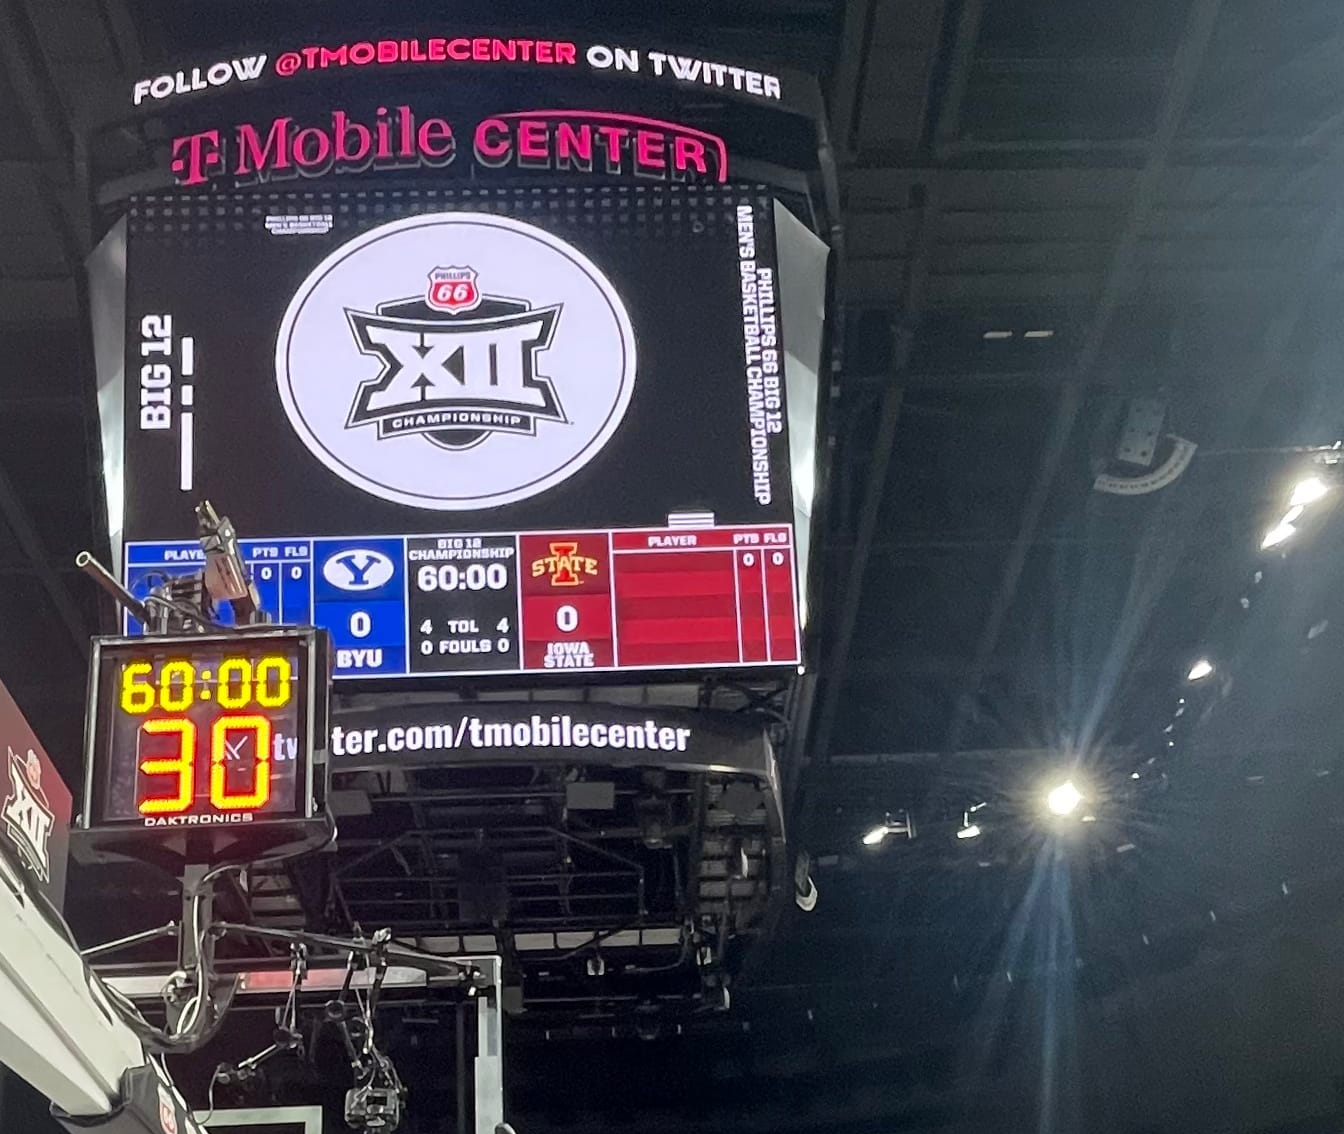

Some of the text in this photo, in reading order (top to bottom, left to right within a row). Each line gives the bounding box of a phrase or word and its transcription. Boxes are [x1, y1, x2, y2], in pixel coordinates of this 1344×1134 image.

[133, 38, 781, 104] FOLLOW @TMOBILECENTER ON TWITTER
[170, 106, 727, 186] T Mobile CENTER
[437, 284, 469, 301] 66
[737, 205, 771, 505] MEN'S BASKETBALL CHAMPIONSHIP
[757, 267, 782, 433] PHILLIPS 66 BIG 12
[139, 313, 173, 431] BIG 12
[392, 413, 521, 429] CHAMPIONSHIP
[648, 536, 697, 547] PLAYER
[164, 549, 206, 561] PLAYE
[408, 547, 515, 561] CHAMPIONSHIP
[742, 551, 785, 566] 0 0
[261, 567, 303, 580] 0 0
[336, 555, 381, 585] Y
[531, 554, 599, 577] STATE
[417, 564, 508, 592] 60:00
[349, 611, 371, 638] 0
[420, 617, 509, 635] 4 TOL 4
[556, 605, 578, 632] 0
[421, 638, 509, 655] 0 FOULS 0
[547, 643, 590, 655] IOWA
[337, 649, 382, 668] BYU
[543, 654, 594, 668] STATE
[121, 655, 291, 714] 60:00
[138, 715, 272, 816] 30
[144, 813, 254, 827] DAKTRONICS
